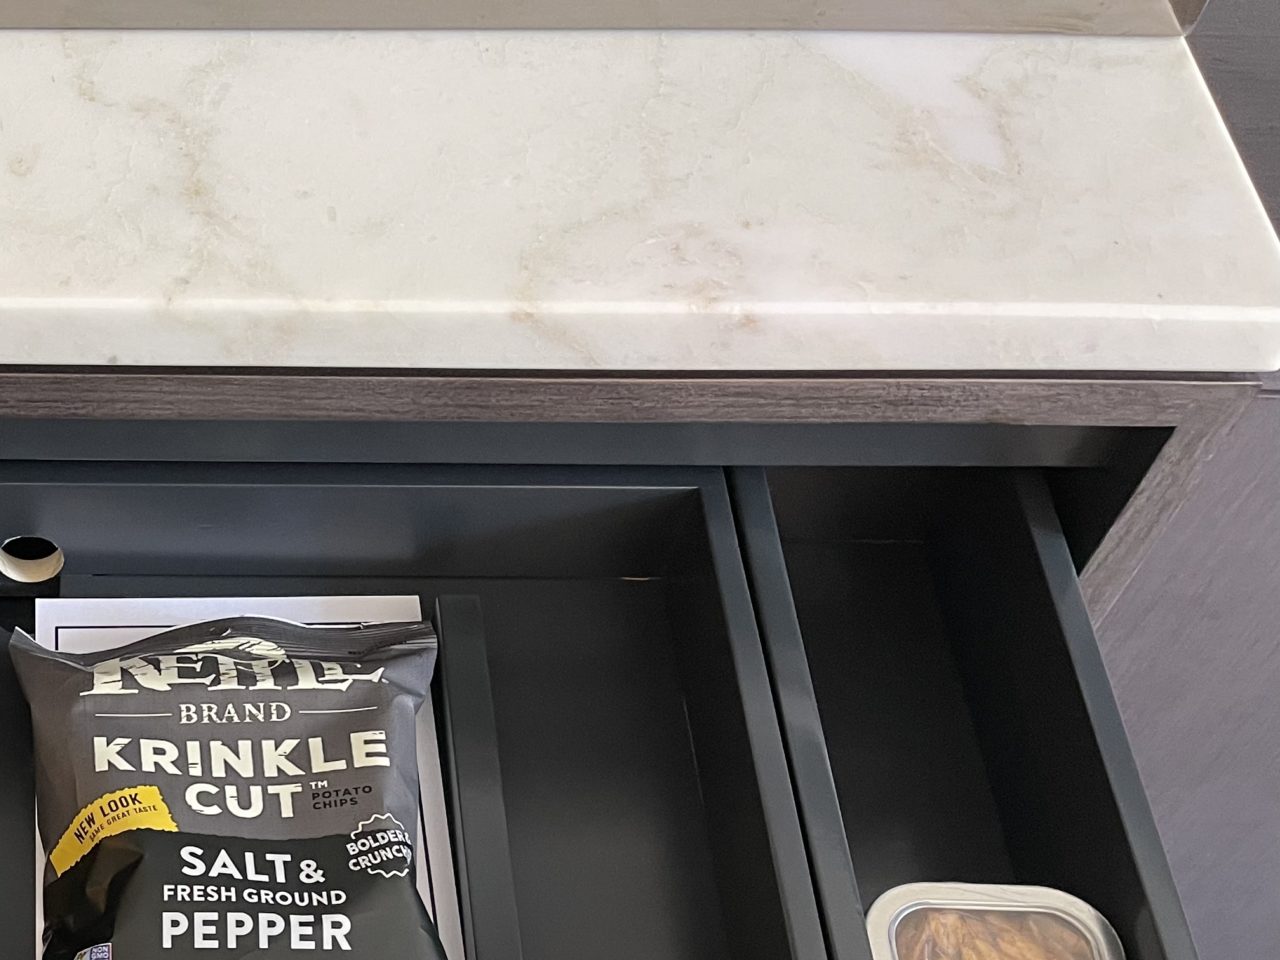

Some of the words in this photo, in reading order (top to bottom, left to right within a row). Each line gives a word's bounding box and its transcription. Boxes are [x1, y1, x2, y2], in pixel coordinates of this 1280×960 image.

[179, 702, 292, 726] BRAND
[93, 730, 391, 778] KRINKLE
[312, 785, 373, 801] POTATO
[313, 797, 359, 810] CHIPS
[74, 812, 96, 844] NEW
[99, 793, 142, 818] LOOK
[89, 825, 104, 842] SAME
[107, 811, 131, 825] GREAT
[134, 805, 158, 814] TASTE
[346, 830, 405, 856] BOLDER
[180, 846, 291, 883] SALT
[299, 860, 326, 884] &
[163, 884, 236, 902] FRESH
[243, 888, 347, 906] GROUND
[162, 911, 352, 950] PEPPER
